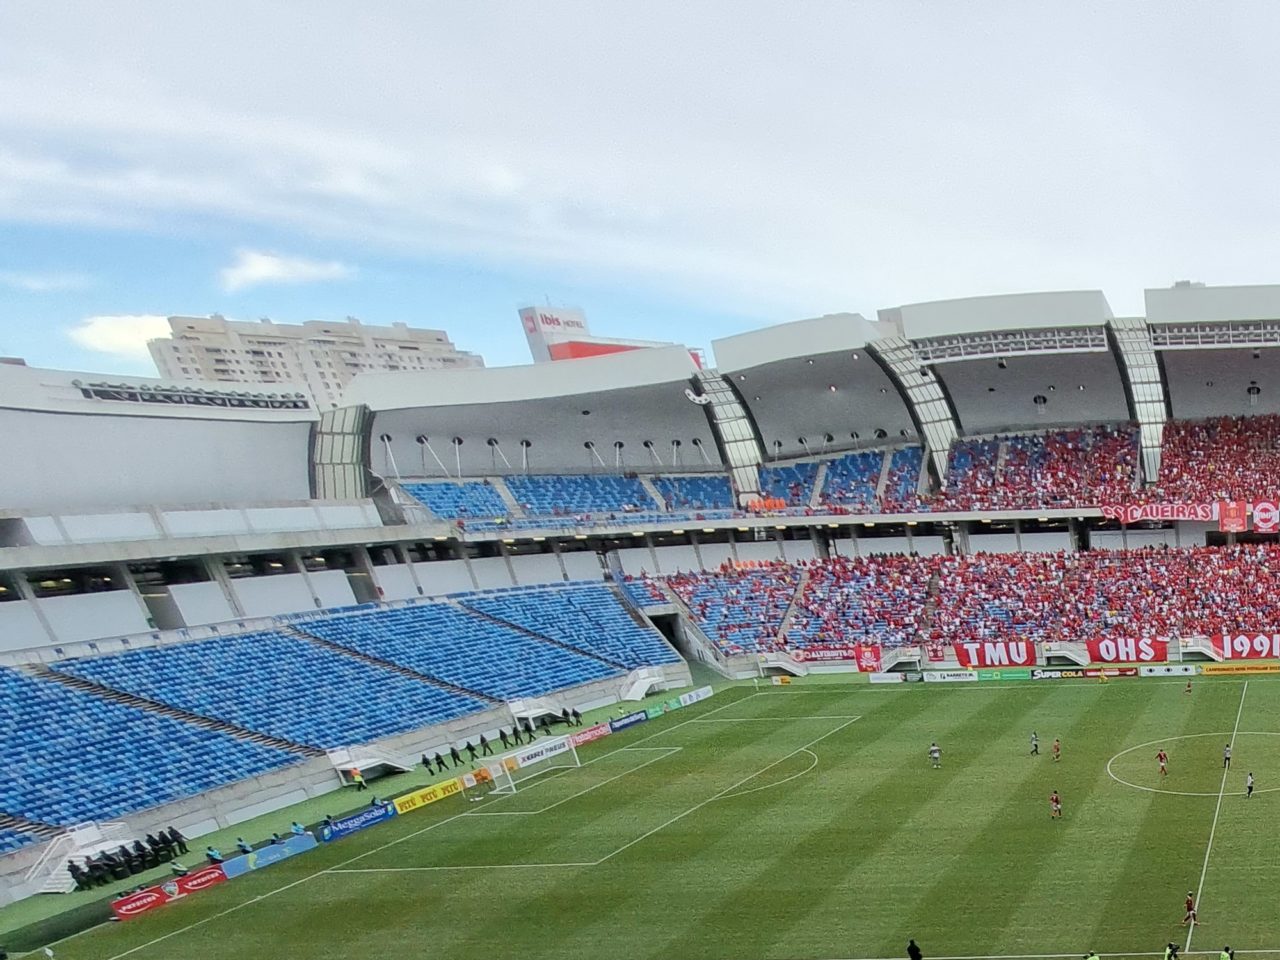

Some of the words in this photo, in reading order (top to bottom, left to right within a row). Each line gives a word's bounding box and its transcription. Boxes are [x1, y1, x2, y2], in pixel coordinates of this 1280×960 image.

[963, 642, 1029, 666] TMU
[1100, 638, 1156, 661] OHS
[1223, 634, 1280, 658] 1991
[1033, 670, 1061, 679] SUPER
[1062, 670, 1083, 678] COLA
[331, 807, 386, 832] MeggaSolar
